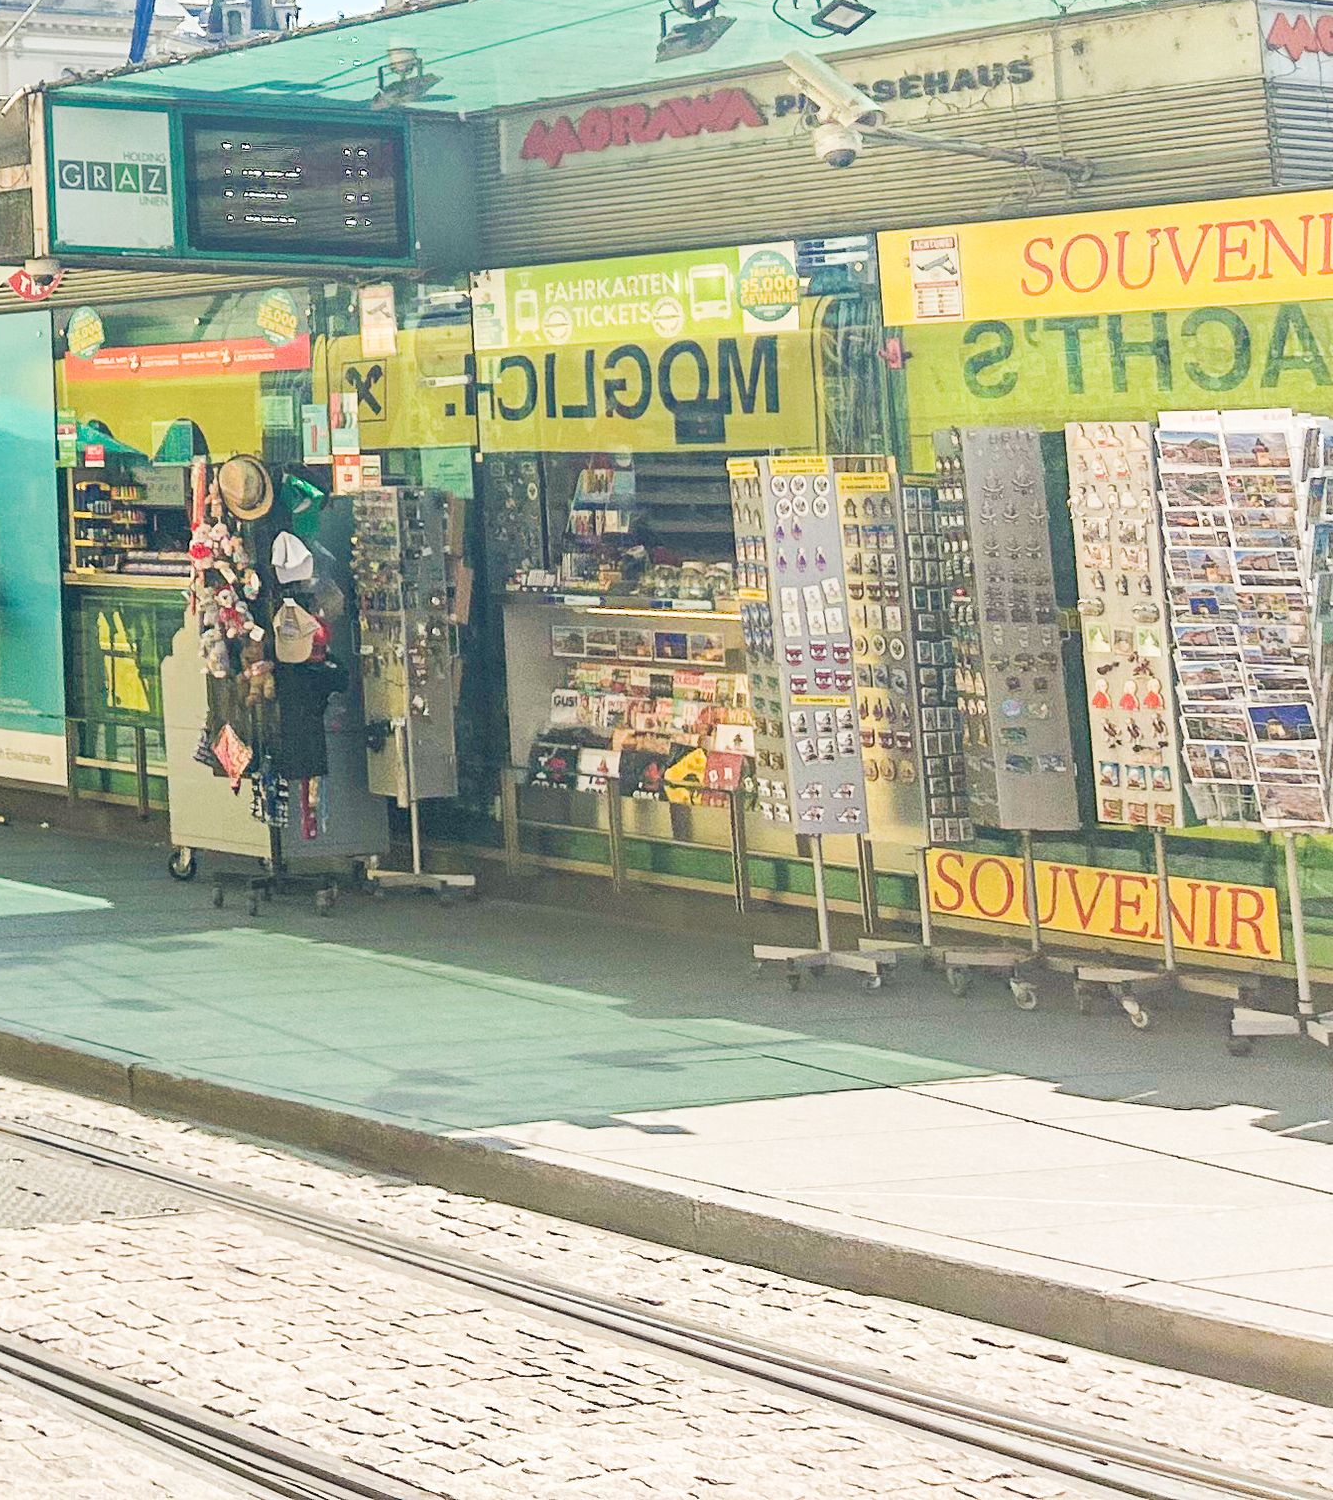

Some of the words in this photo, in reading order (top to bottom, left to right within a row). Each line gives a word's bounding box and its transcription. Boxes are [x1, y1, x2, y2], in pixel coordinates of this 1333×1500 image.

[520, 88, 769, 168] MORAWA
[123, 152, 167, 164] HOLDING
[61, 162, 164, 193] GRAZ
[139, 196, 169, 206] LINIEN
[544, 271, 680, 305] FAHRKARTEN
[572, 301, 652, 330] TICKETS
[934, 851, 1271, 955] SOUVENIR
